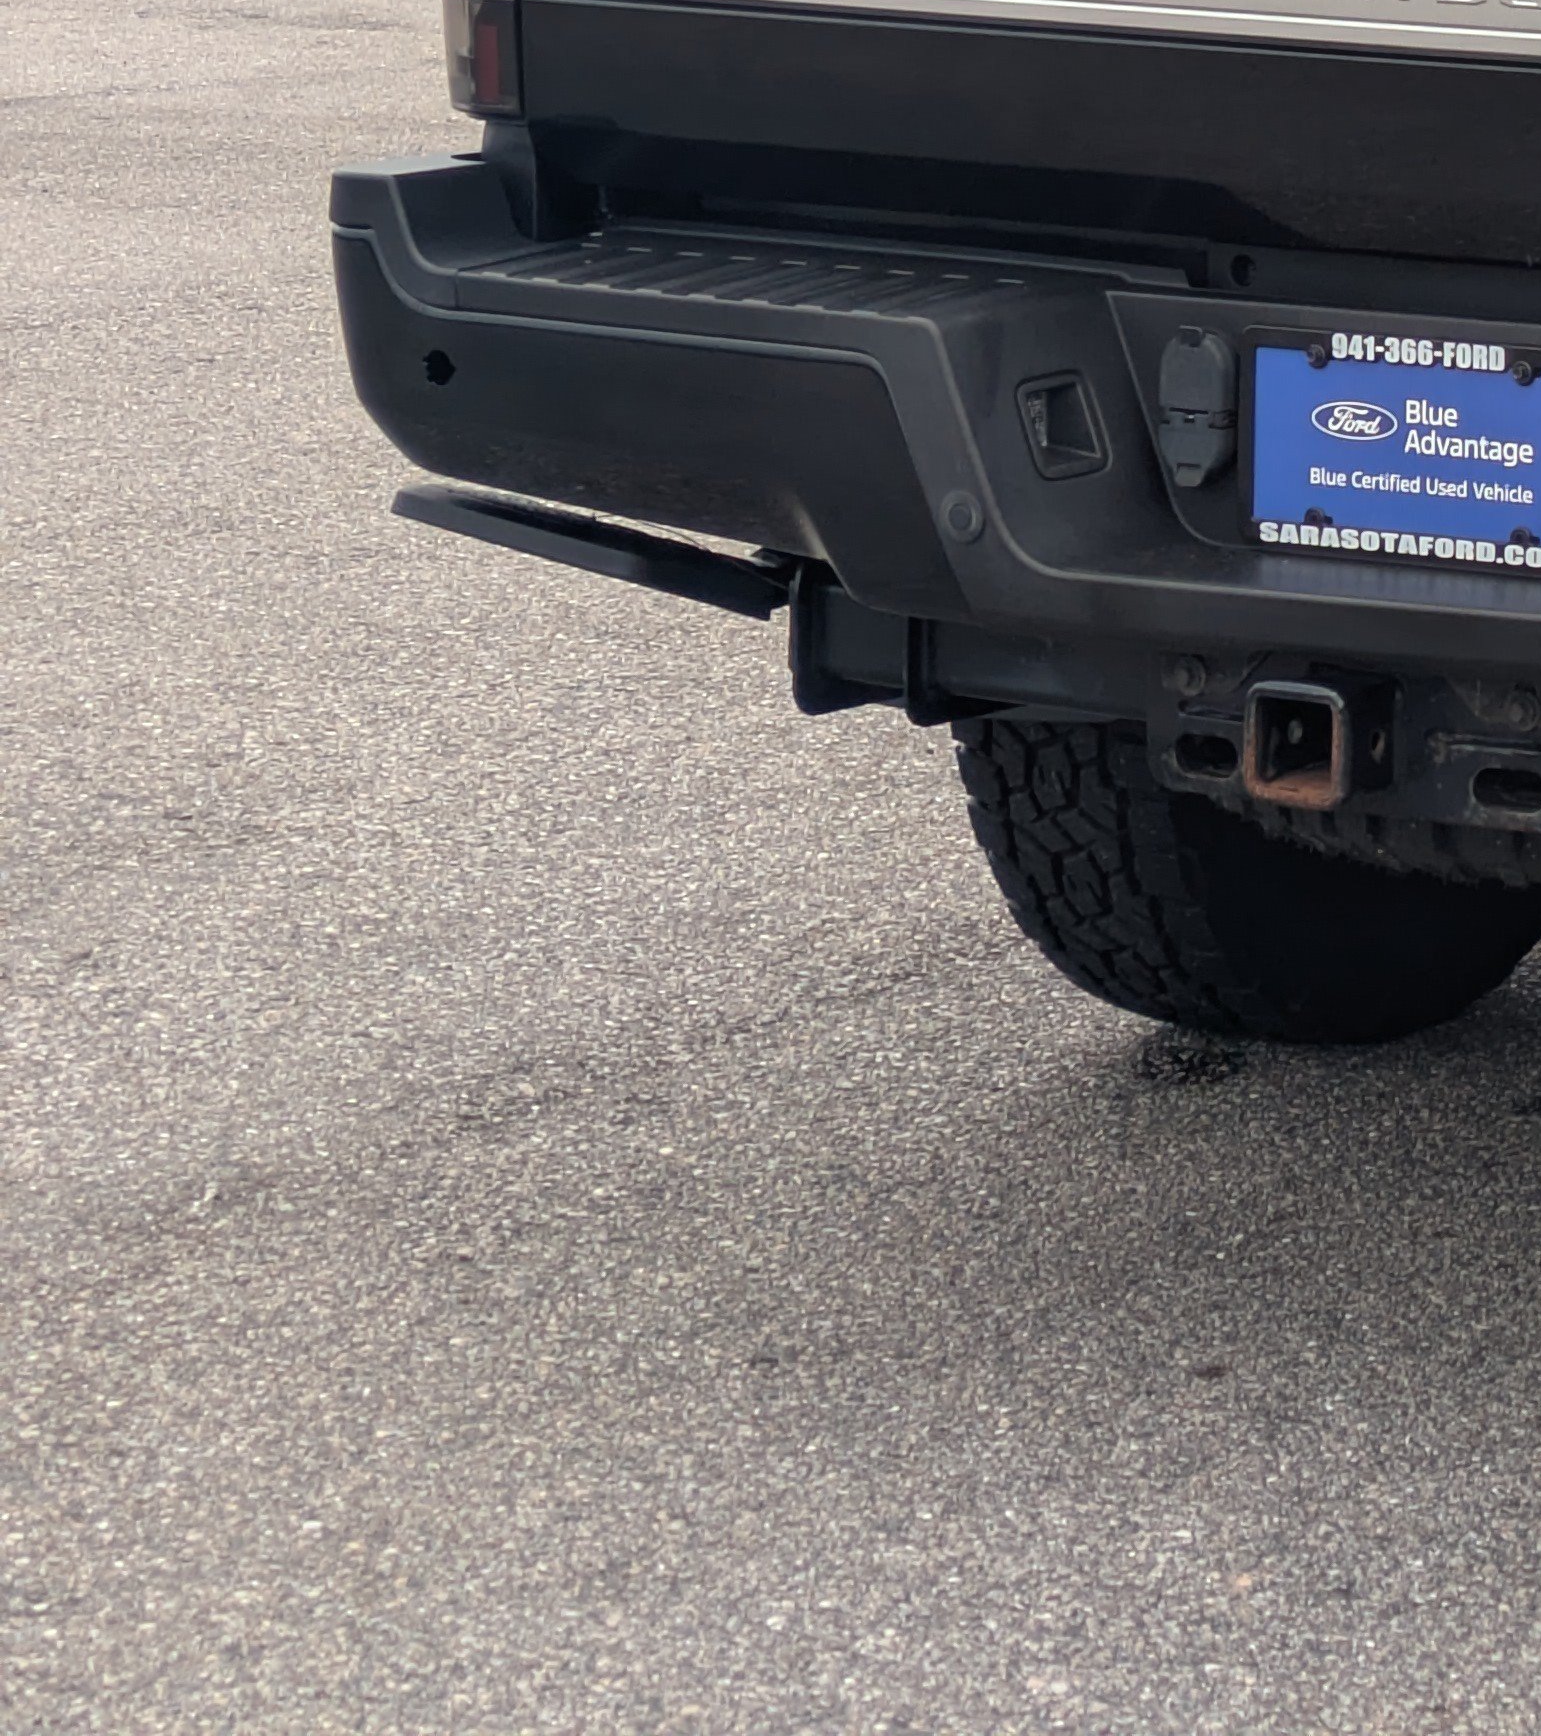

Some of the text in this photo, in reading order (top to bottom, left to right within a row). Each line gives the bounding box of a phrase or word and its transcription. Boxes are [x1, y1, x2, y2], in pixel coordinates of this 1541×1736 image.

[1331, 332, 1506, 372] 941-366-FORD
[1327, 405, 1382, 435] Ford
[1404, 399, 1458, 428] Blue
[1403, 429, 1534, 467] Advantage
[1309, 467, 1534, 504] Blue Certified Used Vehicle
